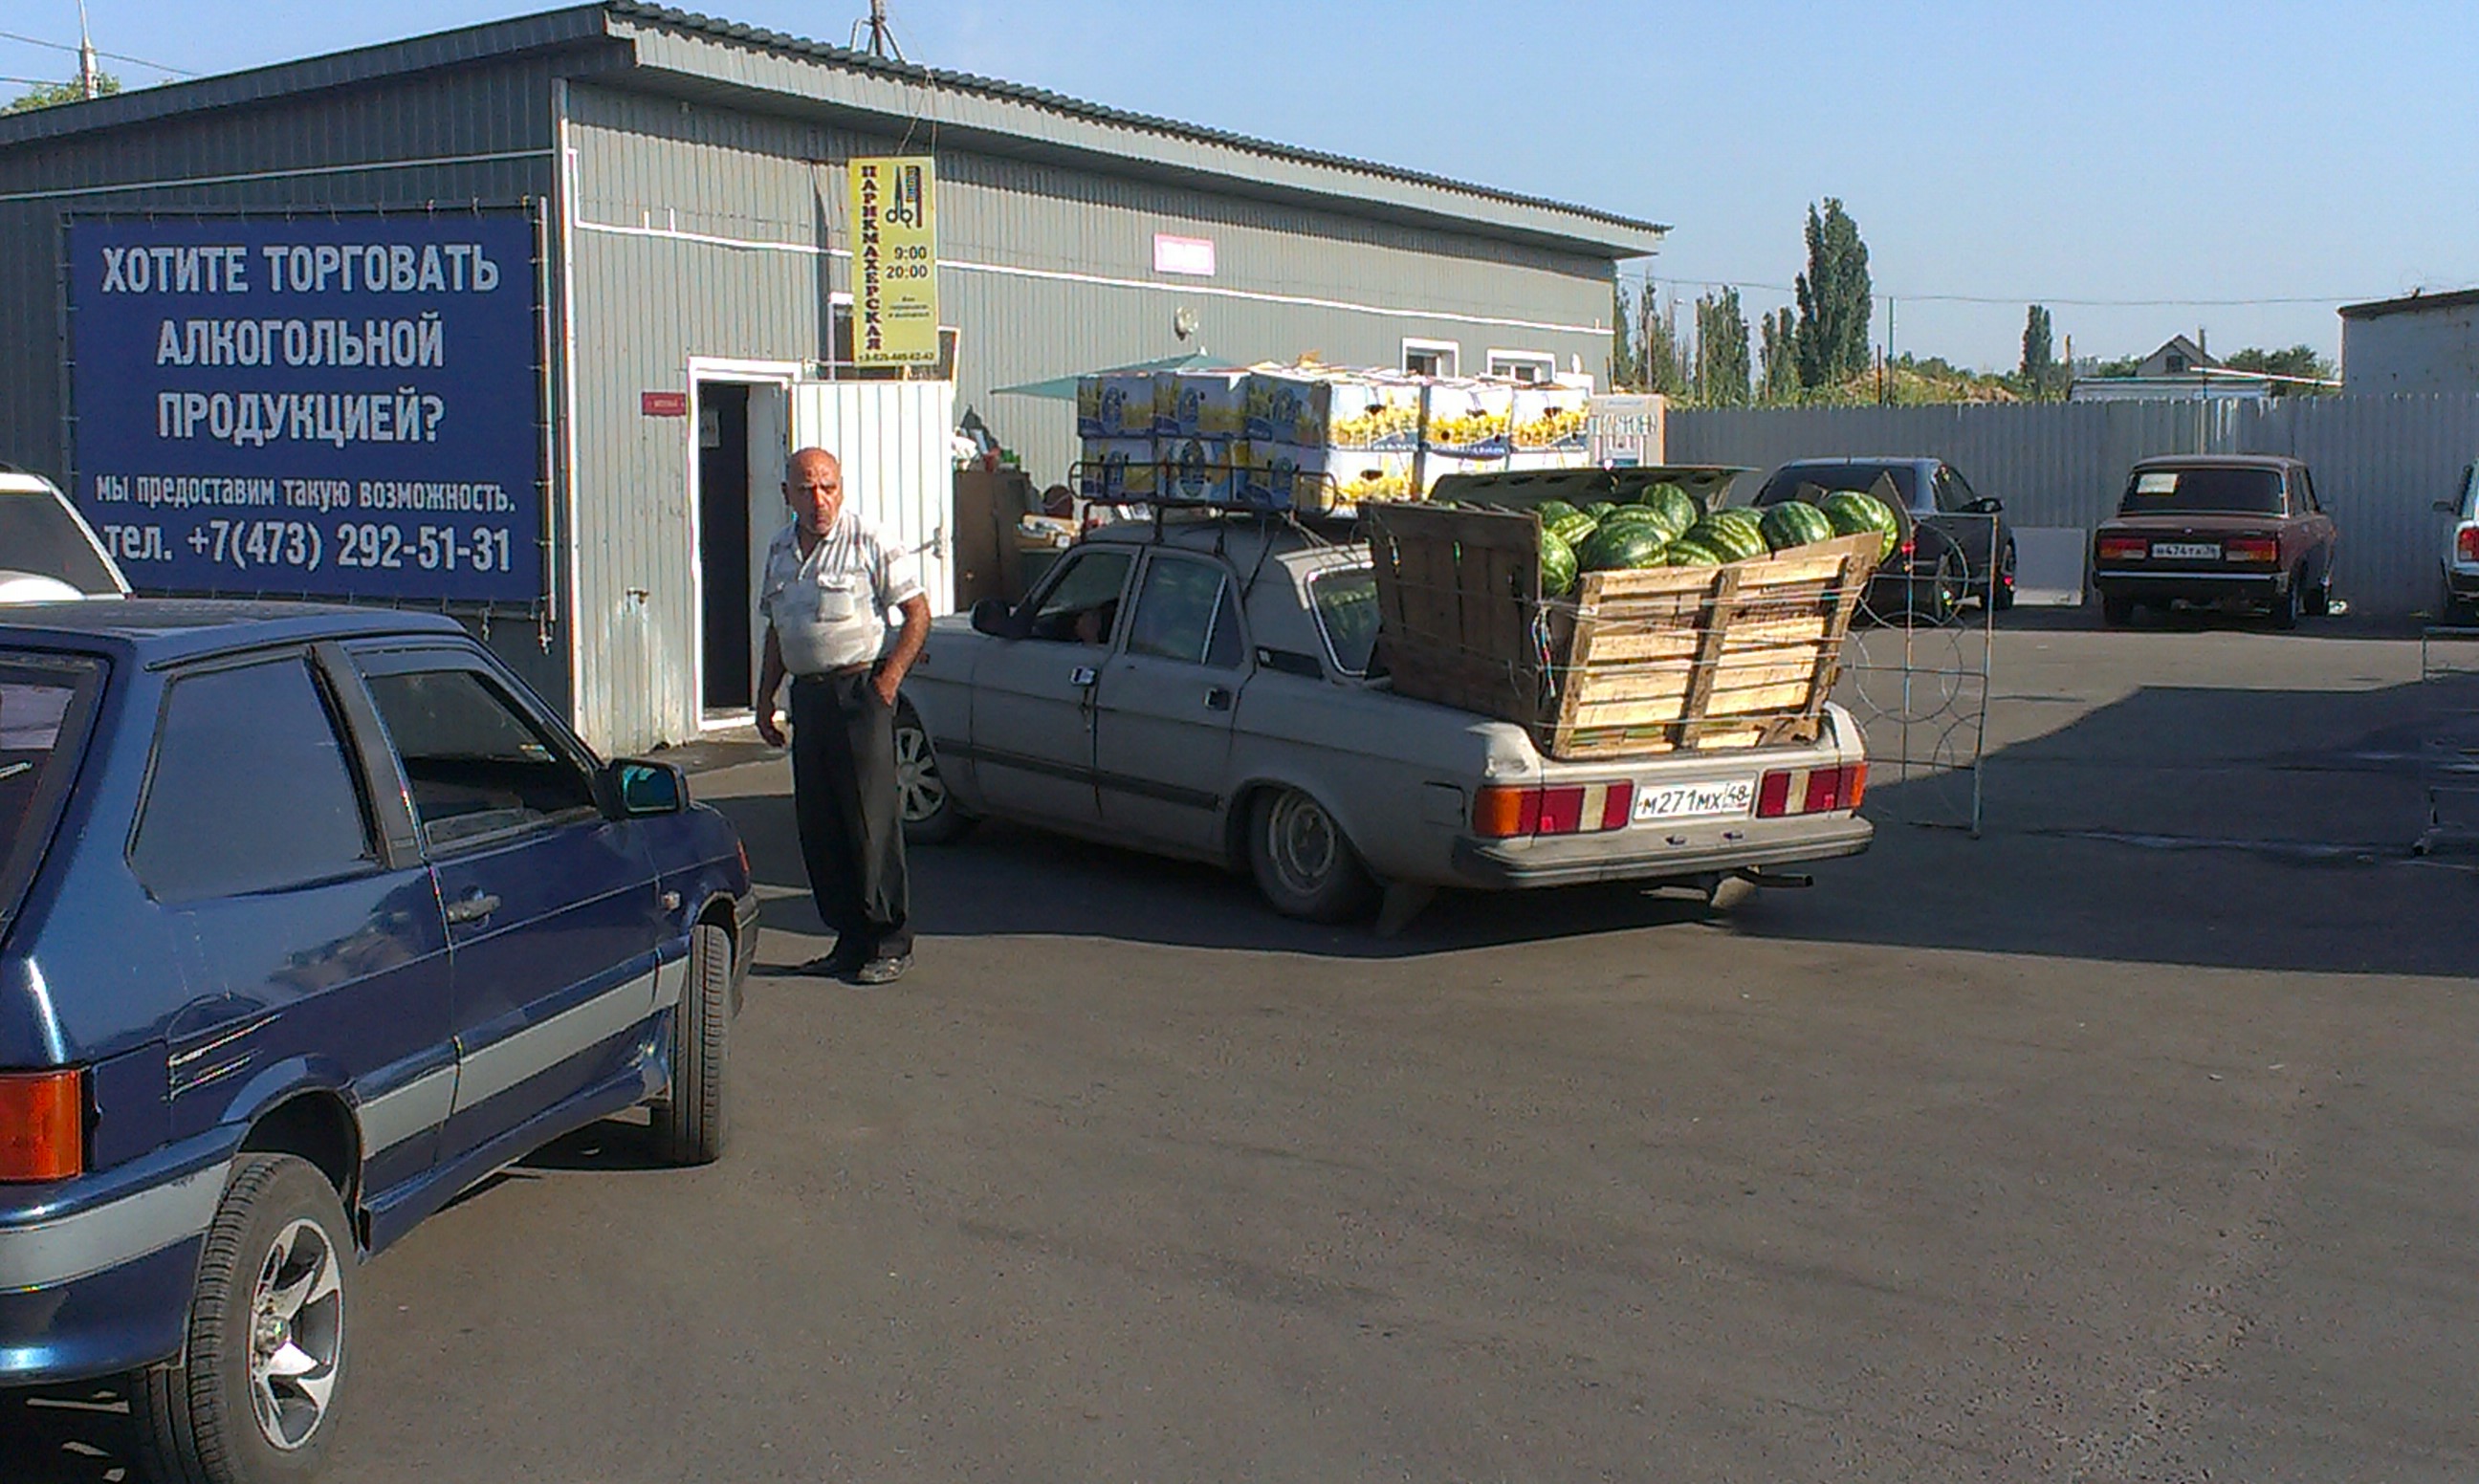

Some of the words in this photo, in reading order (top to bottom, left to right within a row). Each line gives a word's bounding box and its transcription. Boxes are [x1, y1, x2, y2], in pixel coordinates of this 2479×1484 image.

[101, 247, 249, 293] ХОТИТЕ
[263, 245, 498, 291] ТОРГОВАТЬ
[861, 165, 882, 350] ПАРИКМАХЕРСКАЯ
[886, 265, 928, 279] 20:00
[894, 246, 927, 260] 9:00
[157, 311, 443, 367] АЛКОГОЛЬНОЙ
[158, 386, 444, 447] ПРОДУКЦИЕЙ?
[137, 476, 274, 509] предоставим
[282, 479, 351, 513] такую
[360, 481, 516, 512] возможность.
[104, 525, 172, 561] тел.
[187, 520, 321, 571] +7(473)
[338, 523, 509, 572] 292-51-31
